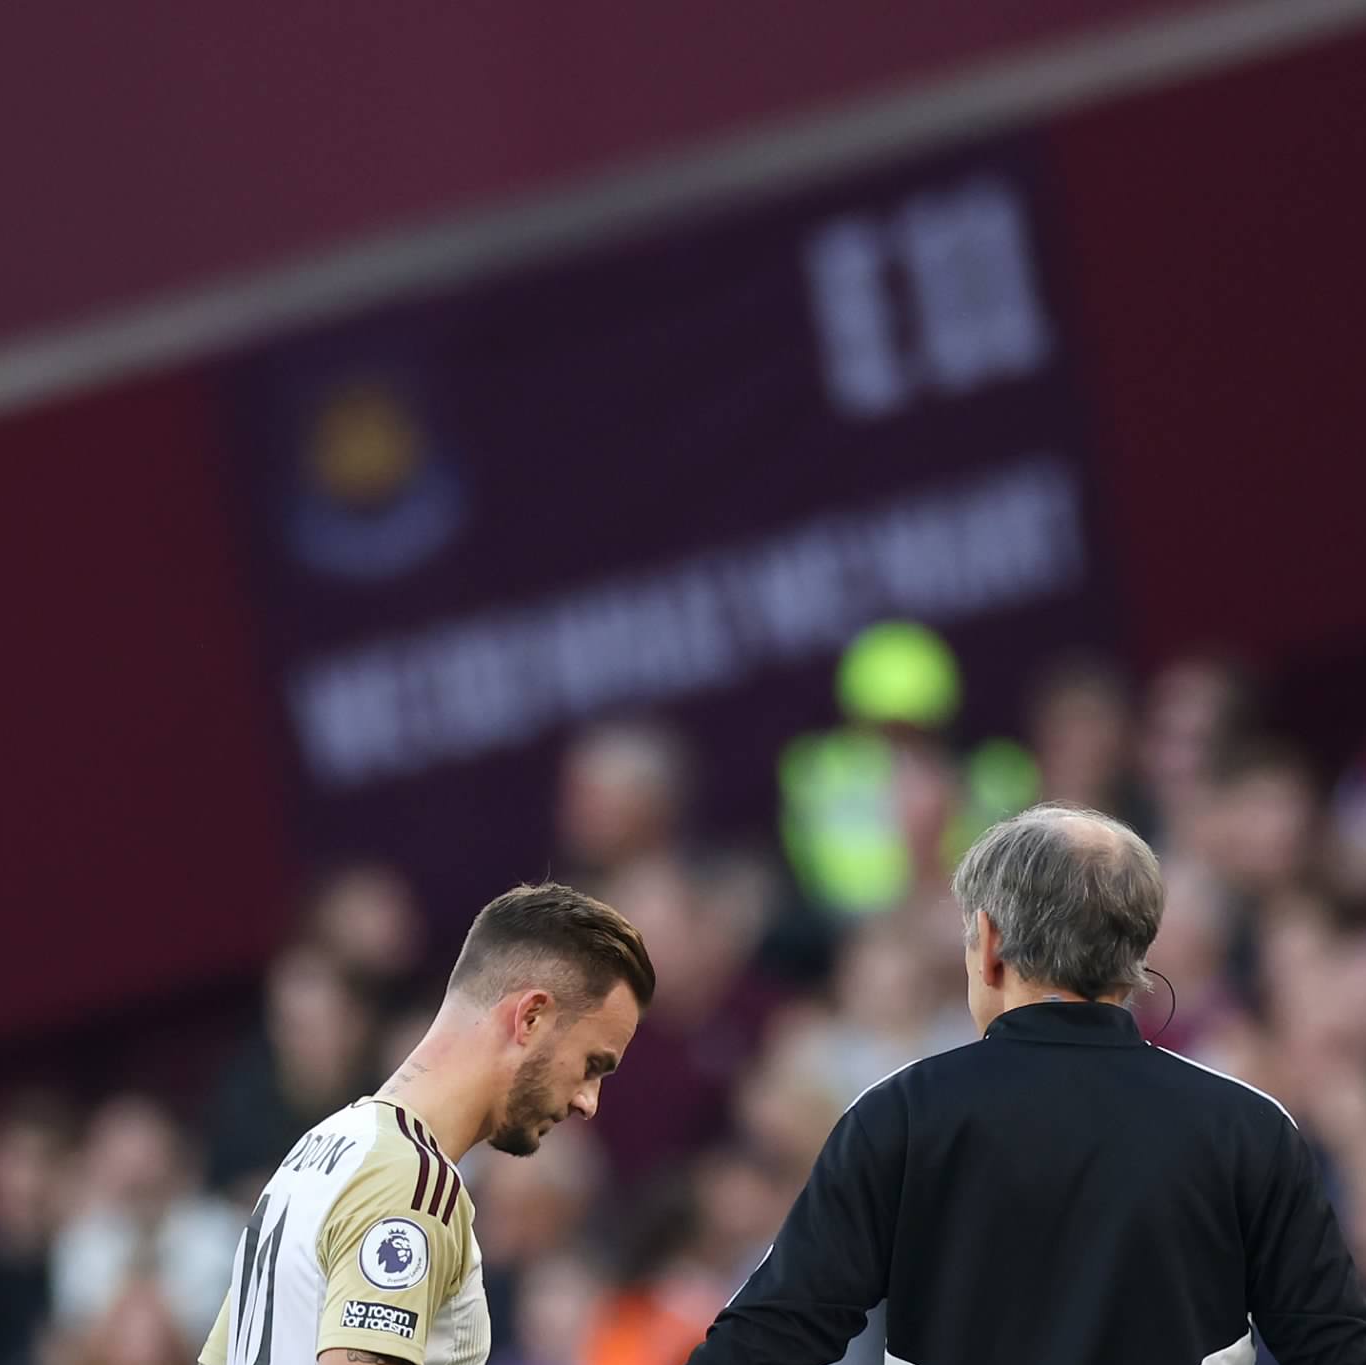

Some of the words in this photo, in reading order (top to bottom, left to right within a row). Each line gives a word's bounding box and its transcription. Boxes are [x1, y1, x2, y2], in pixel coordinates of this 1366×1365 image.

[341, 1313, 364, 1328] for
[364, 1317, 414, 1339] racism
[344, 1301, 366, 1316] No
[368, 1305, 410, 1326] room
